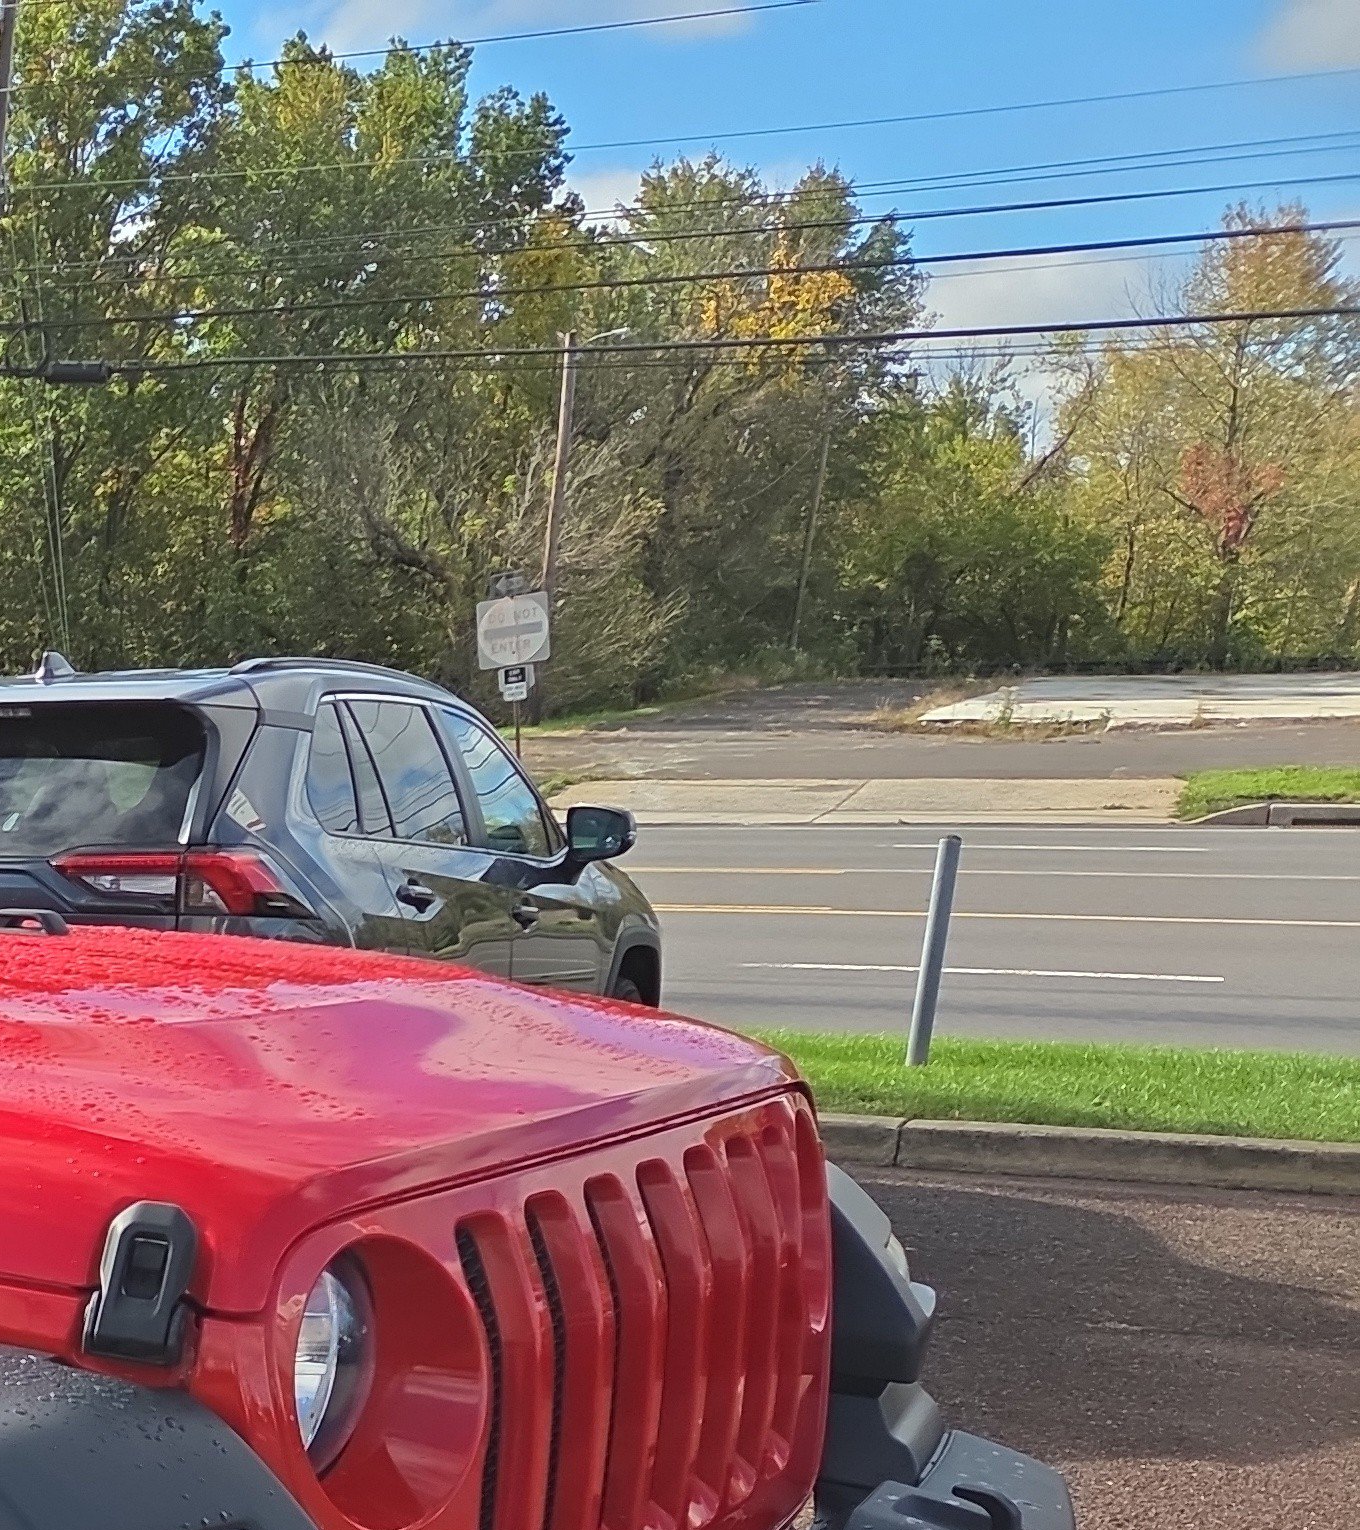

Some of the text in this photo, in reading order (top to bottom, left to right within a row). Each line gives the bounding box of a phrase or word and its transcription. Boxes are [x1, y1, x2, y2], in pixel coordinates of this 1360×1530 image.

[488, 607, 538, 624] DO NOT
[490, 639, 531, 655] ENTER
